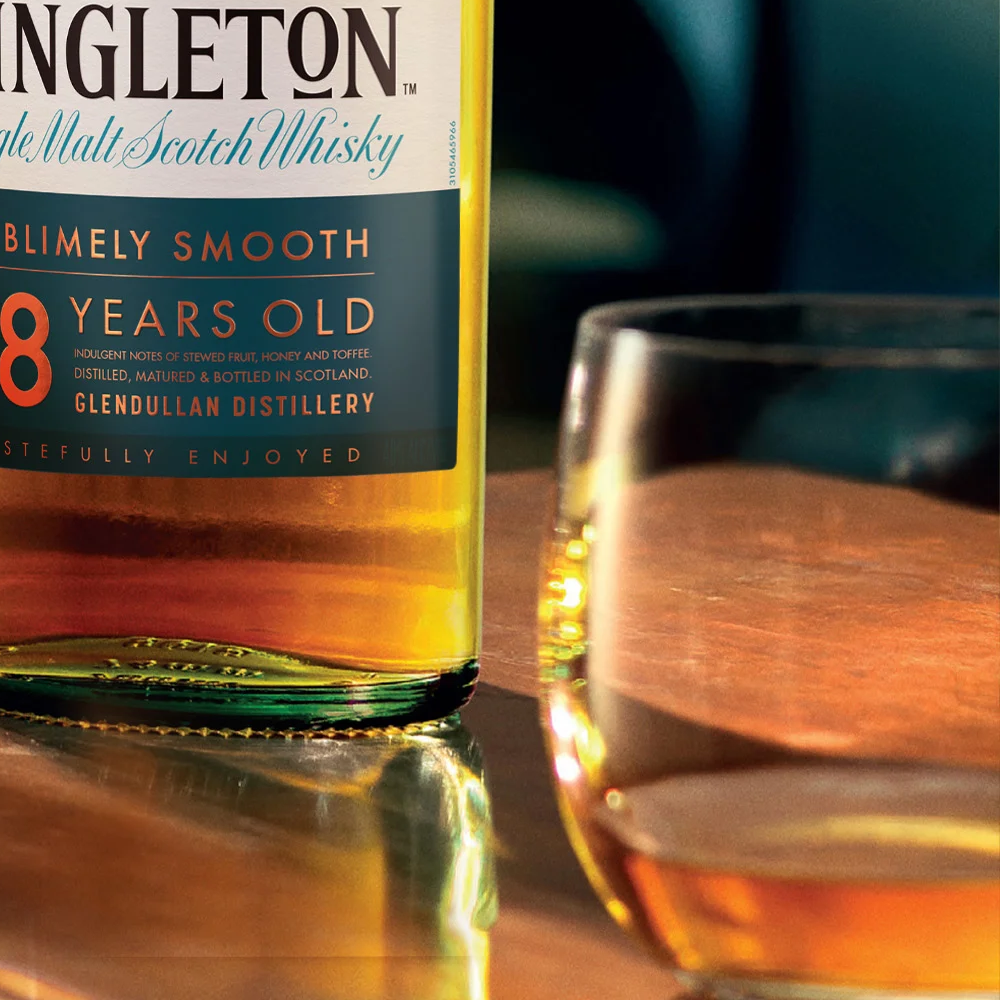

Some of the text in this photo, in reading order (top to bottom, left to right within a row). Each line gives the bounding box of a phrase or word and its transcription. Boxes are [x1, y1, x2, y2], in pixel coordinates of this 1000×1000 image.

[26, 108, 124, 165] Malt
[113, 109, 255, 169] Scotch
[257, 106, 405, 181] Whisky
[448, 120, 457, 186] 3105465966
[173, 228, 369, 263] SMOOTH
[68, 295, 375, 339] YEARS OLD
[73, 347, 373, 363] INDULGENT NOTES OF STEWED FRUIT, HONEY AND TOFFEE.
[73, 367, 373, 383] DISTILLED, MATURED & BOTTLED IN SCOTLAND.
[74, 391, 375, 417] GLENDULLAN DISTILLERY
[189, 447, 361, 465] ENJOYED
